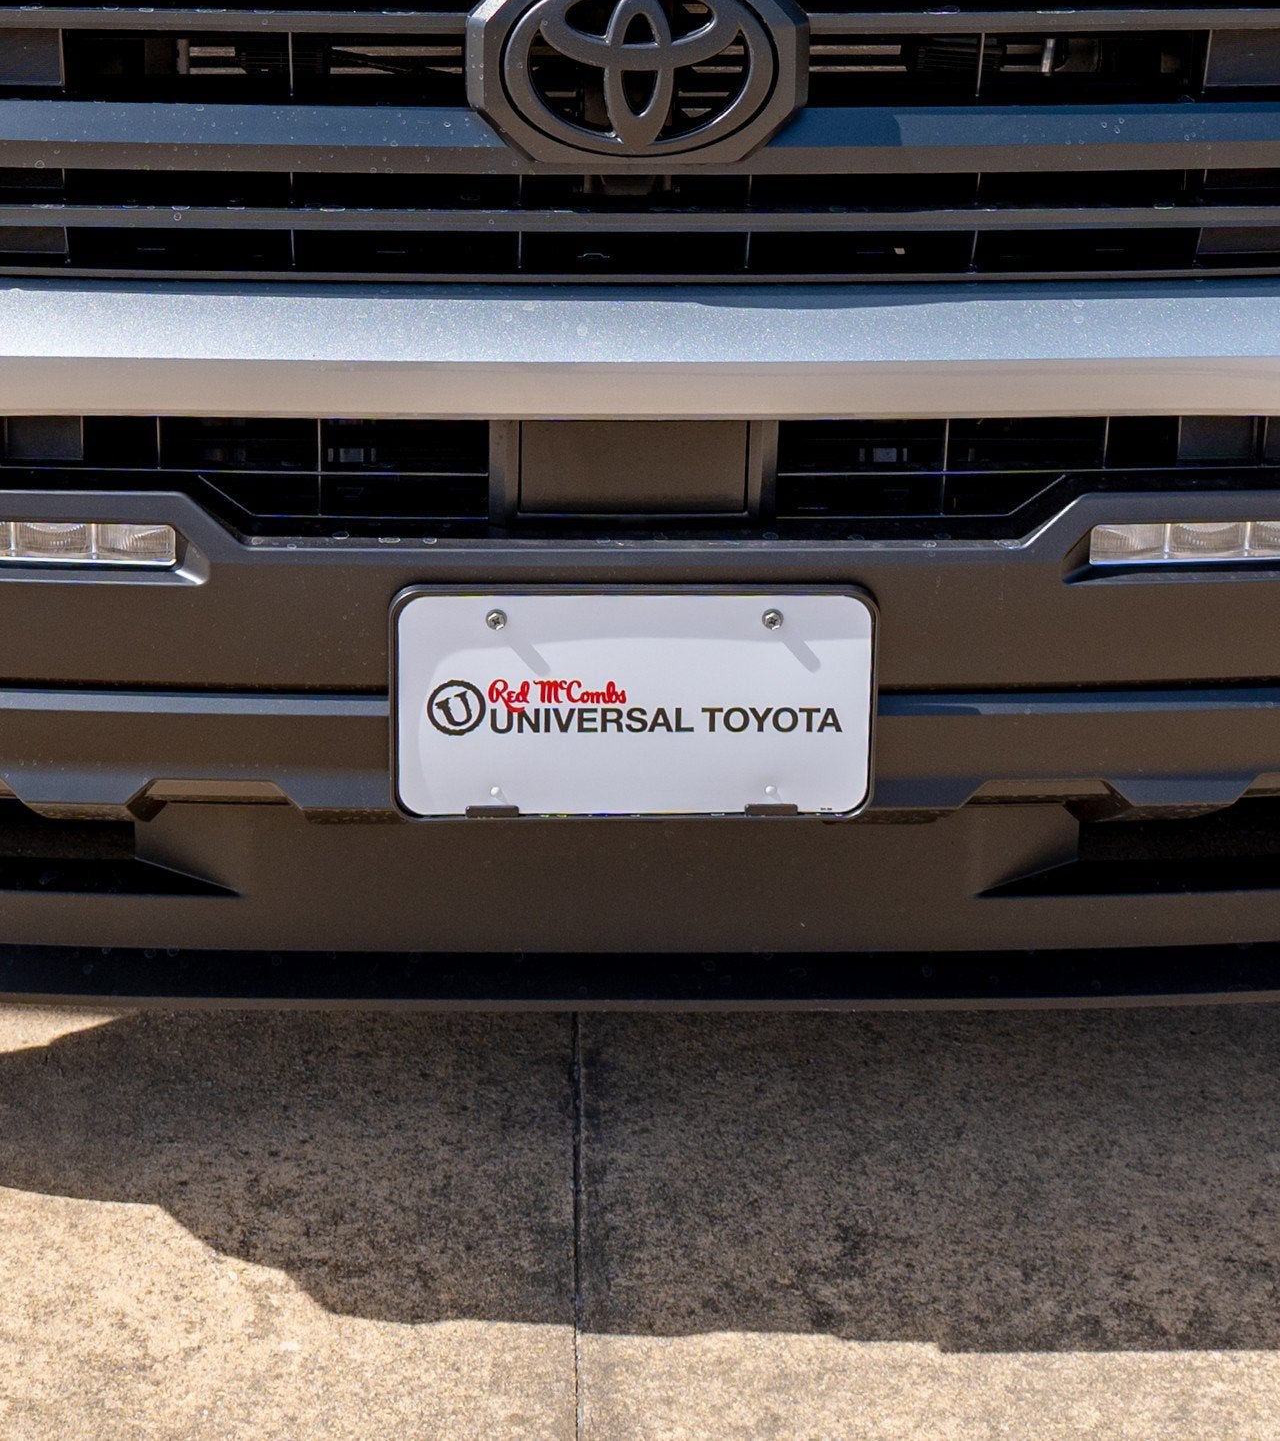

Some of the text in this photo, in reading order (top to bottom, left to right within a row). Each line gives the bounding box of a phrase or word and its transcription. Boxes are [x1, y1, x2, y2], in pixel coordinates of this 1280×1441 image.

[488, 679, 627, 713] Red McCombs
[490, 707, 695, 734] UNIVERSAL
[701, 707, 843, 733] TOYOTA
